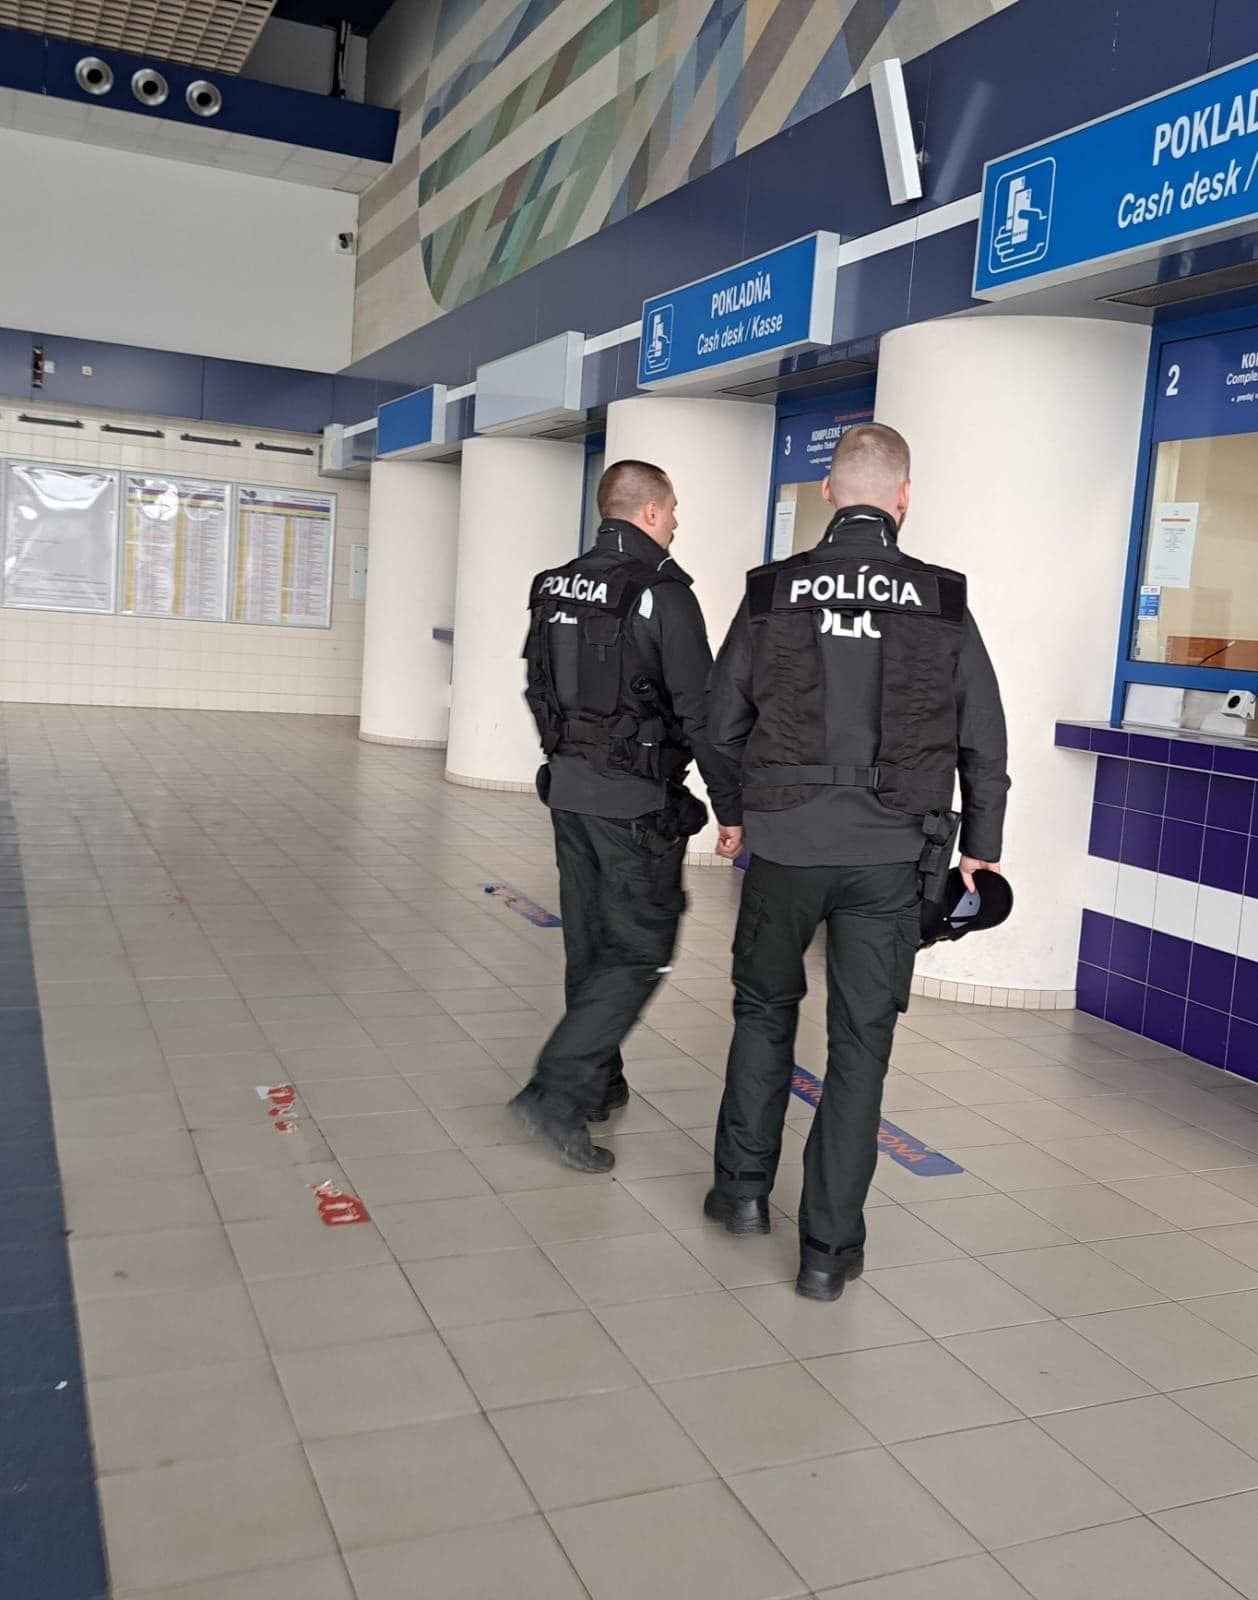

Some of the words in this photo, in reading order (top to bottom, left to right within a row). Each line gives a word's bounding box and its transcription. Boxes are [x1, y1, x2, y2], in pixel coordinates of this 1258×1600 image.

[1117, 181, 1174, 229] Cash
[1180, 159, 1242, 210] desk
[711, 271, 771, 319] POKLADŇA
[697, 329, 719, 355] Cash
[721, 320, 744, 348] desk
[751, 313, 783, 339] Kasse
[1165, 364, 1180, 396] 2
[784, 435, 792, 455] 3
[539, 574, 607, 604] POLÍCIA
[790, 565, 922, 606] POLÍCIA
